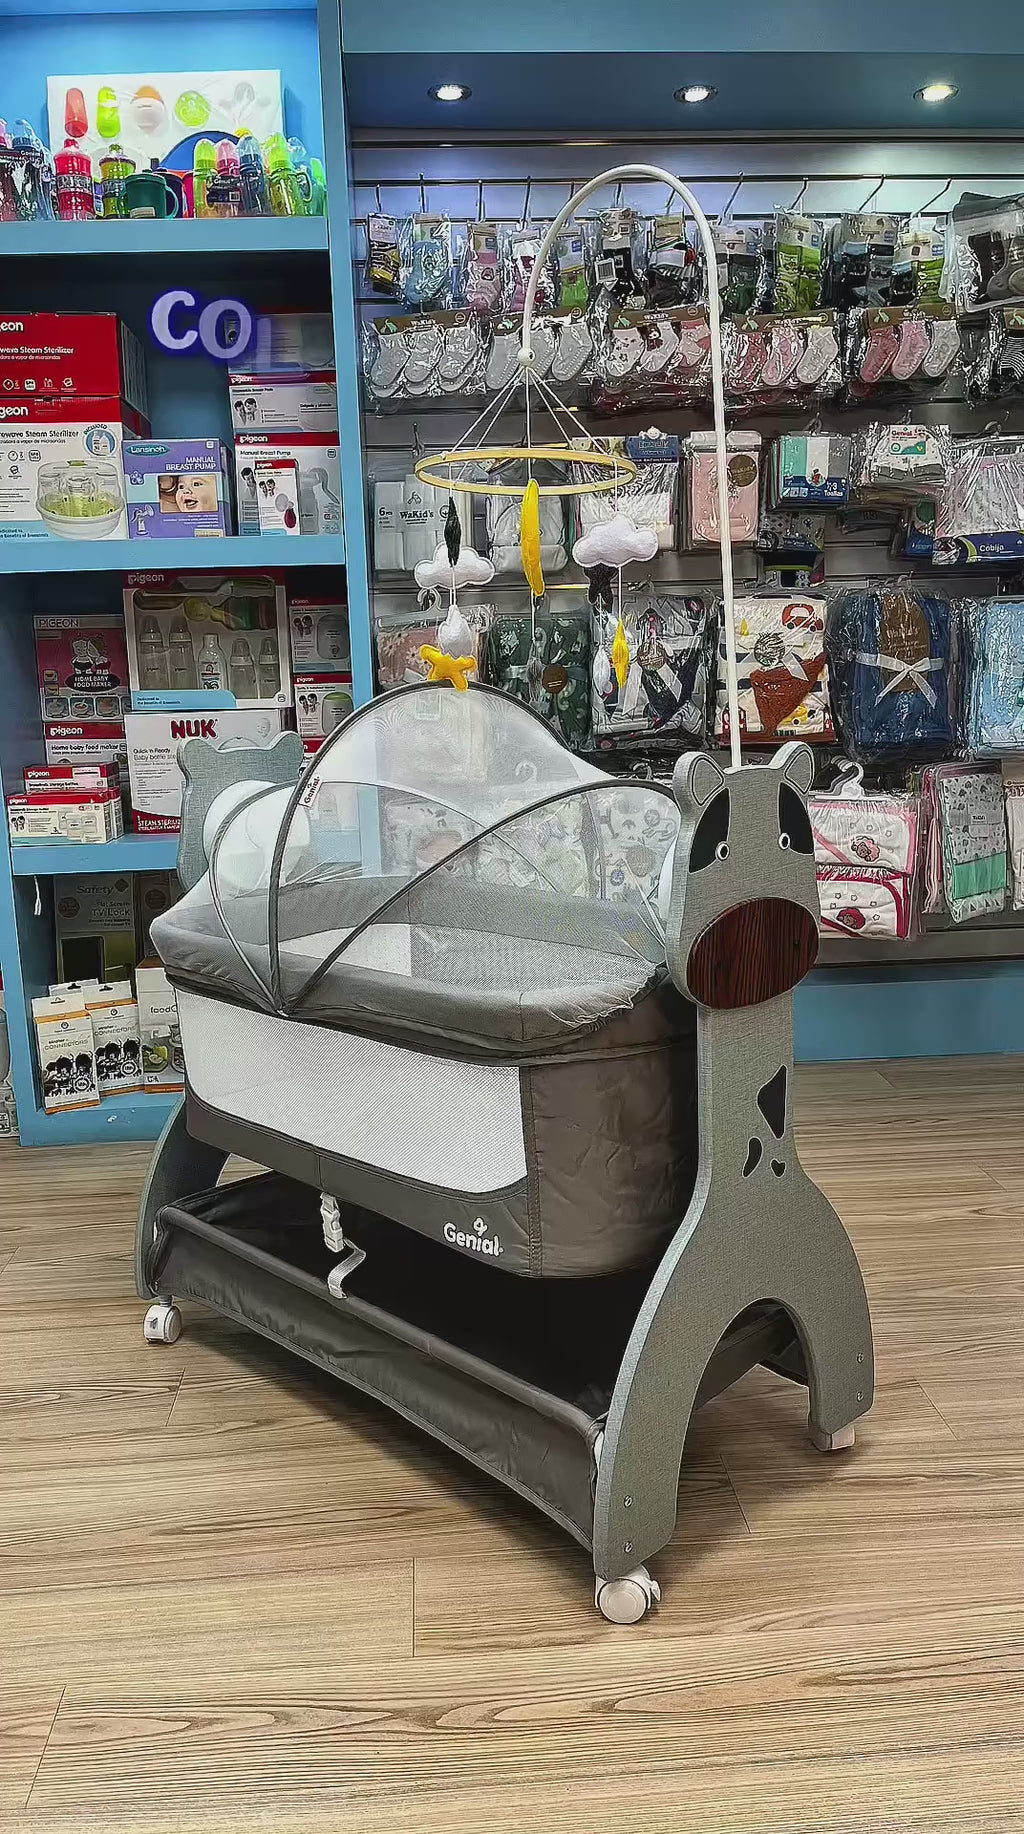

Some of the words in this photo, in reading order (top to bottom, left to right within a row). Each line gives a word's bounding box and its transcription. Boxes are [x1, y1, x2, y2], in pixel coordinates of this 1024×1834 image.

[0, 321, 24, 332] eon
[20, 346, 43, 354] Steam
[25, 430, 48, 438] Steam
[240, 434, 268, 444] pigeon
[130, 445, 166, 454] Lansinoh
[165, 463, 194, 471] BREAST
[400, 510, 434, 519] WaKid's
[127, 572, 165, 585] pigeon
[39, 618, 79, 628] PIGEON
[50, 726, 83, 736] pigeon
[170, 718, 217, 738] NUK
[69, 744, 84, 752] baby
[27, 770, 50, 778] pigeon
[304, 776, 320, 804] Genial
[76, 884, 114, 895] Safety
[107, 908, 131, 916] Lock
[94, 1025, 136, 1037] CONNECTORS
[43, 1039, 89, 1051] CONNECTORS
[443, 1217, 503, 1257] Genial
